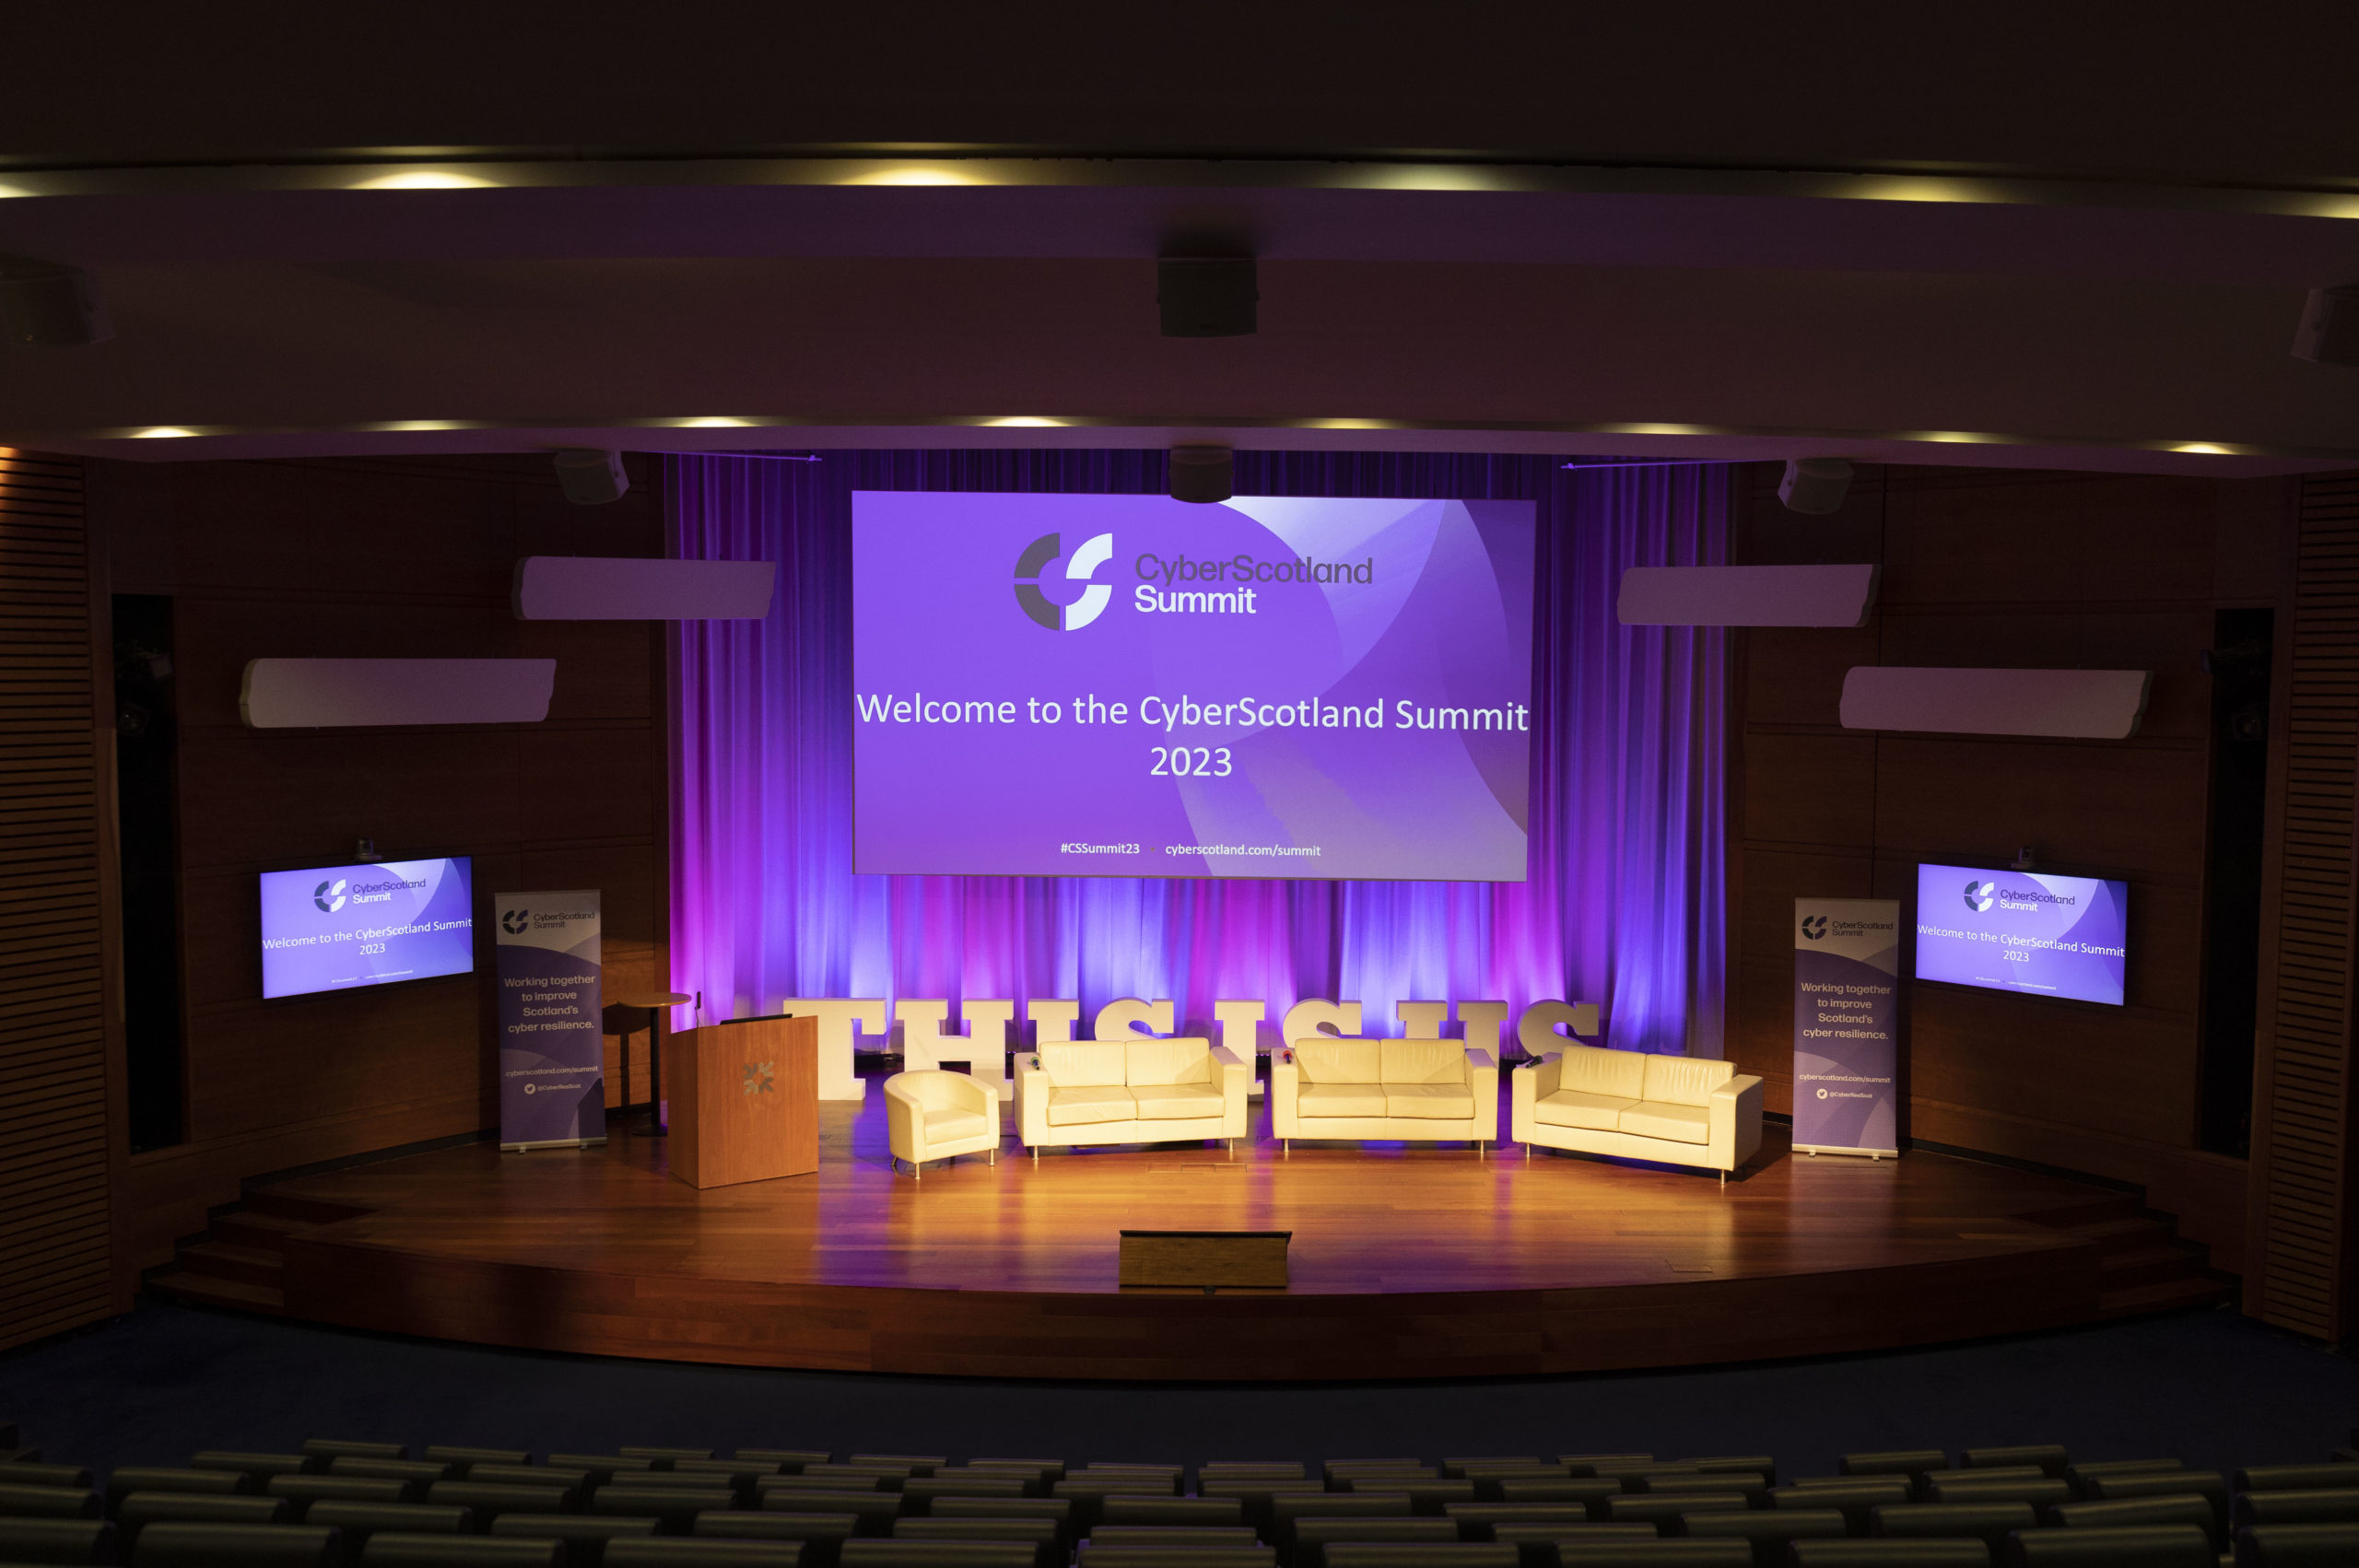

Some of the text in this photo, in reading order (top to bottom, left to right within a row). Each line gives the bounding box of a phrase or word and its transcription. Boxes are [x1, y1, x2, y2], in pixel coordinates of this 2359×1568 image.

[1134, 553, 1373, 585] CyberScotland
[1134, 584, 1256, 614] Summit
[856, 693, 1529, 734] Welcome to the CyberScotland Summit
[1149, 747, 1232, 777] 2023
[1060, 842, 1321, 859] #CSSummit23 cyberscotland.com/summit
[352, 878, 427, 895] CyberScotland
[353, 892, 392, 904] Summit
[2000, 889, 2075, 906] CyberScotland
[2000, 899, 2038, 912] Summit
[534, 912, 595, 921] CyberScotland
[1832, 920, 1894, 930] CyberScotland
[263, 918, 473, 950] Welcome to the CyberScotland Summit
[1918, 924, 2125, 957] Welcome to the CyberScotland Summit
[359, 943, 386, 955] 2023
[2003, 950, 2029, 963] 2023
[504, 975, 596, 988] Working together
[1801, 982, 1892, 995] Working together
[522, 991, 577, 1002] to improve
[522, 1005, 579, 1016] Scotland's
[1817, 998, 1872, 1010] to improve
[1818, 1012, 1873, 1024] Scotland's
[508, 1020, 594, 1035] cyber resilience.
[1802, 1028, 1888, 1040] cyber resilience.
